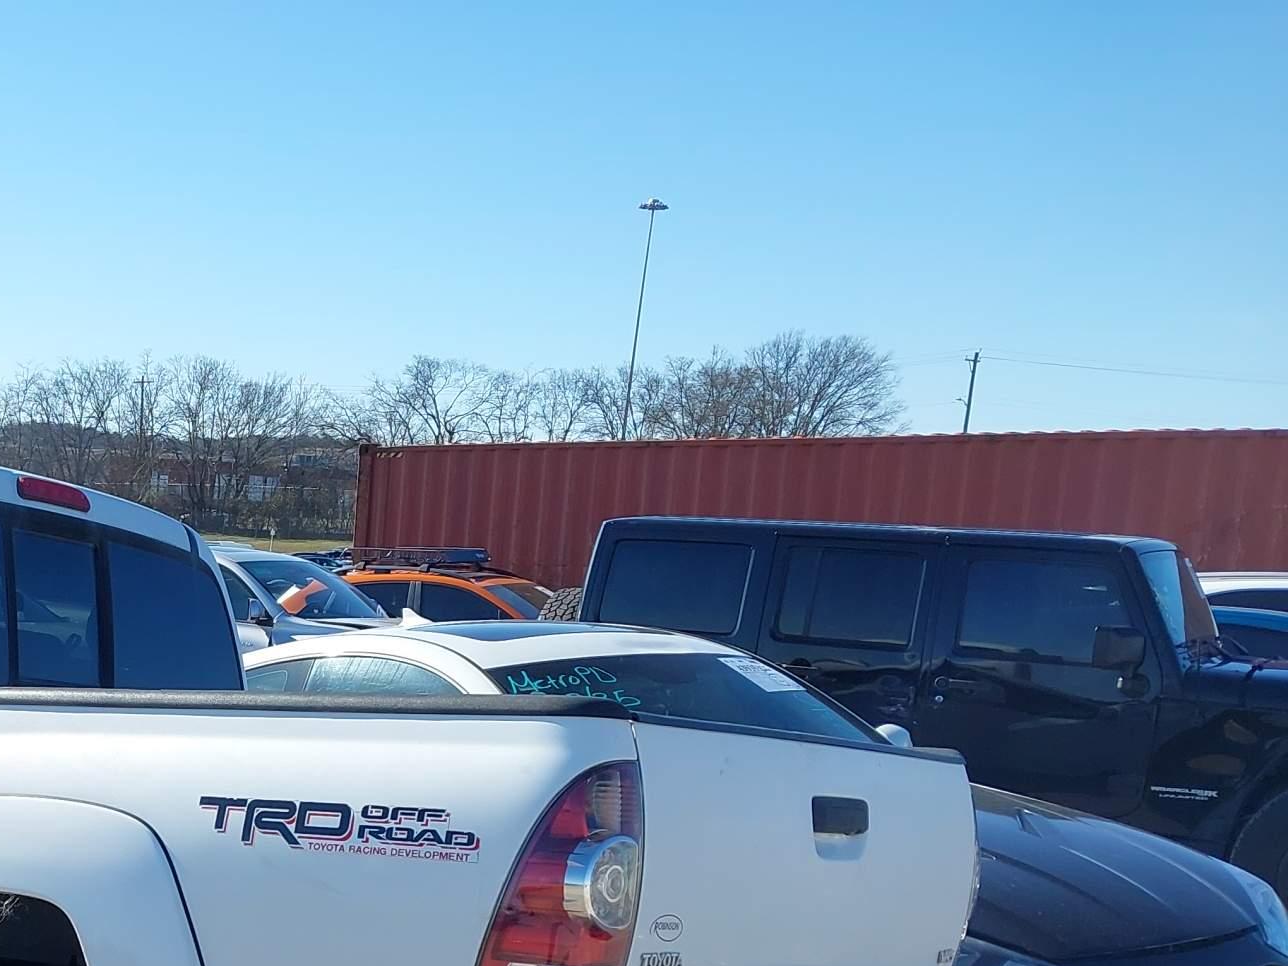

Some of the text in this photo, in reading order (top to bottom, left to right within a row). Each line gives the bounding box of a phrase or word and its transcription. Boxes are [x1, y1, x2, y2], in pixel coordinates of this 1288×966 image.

[199, 796, 354, 850] TRD
[360, 804, 450, 826] OFF
[357, 824, 480, 851] ROAD
[308, 842, 470, 862] TOYOTA RACING DEVELOPMENT
